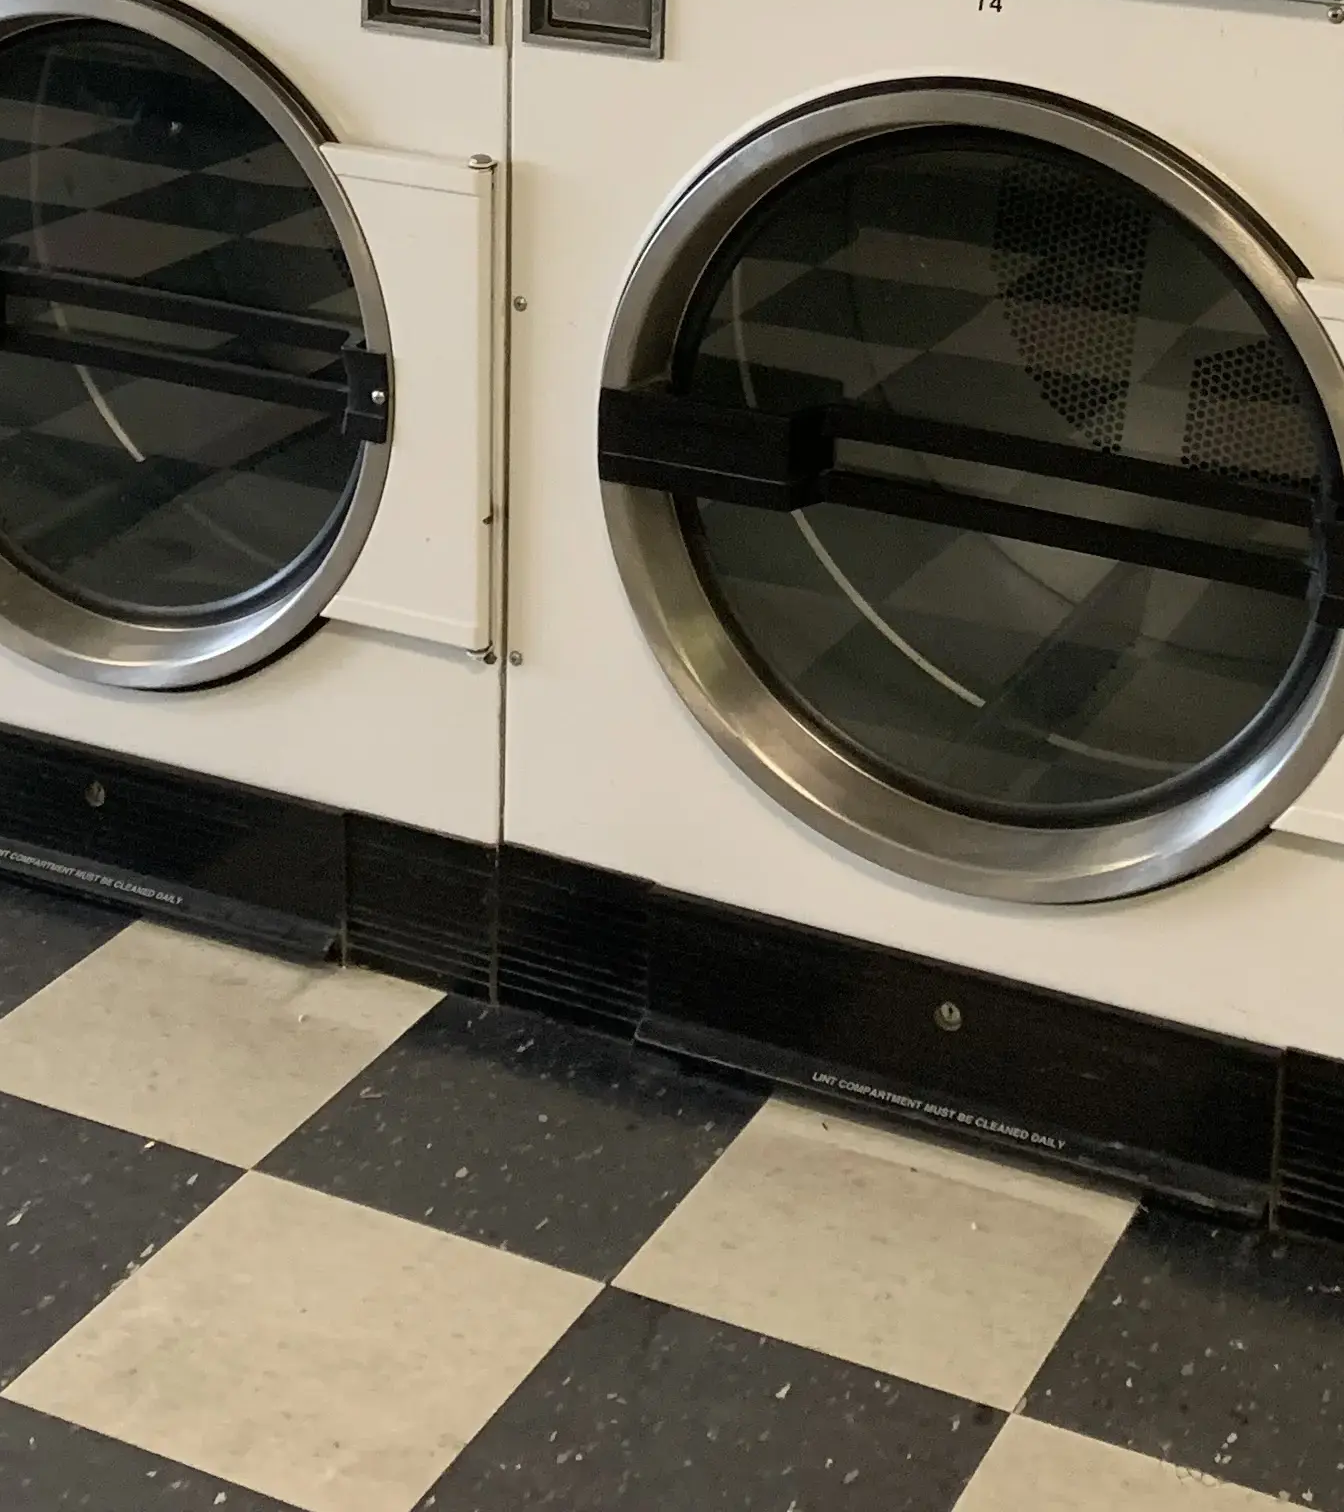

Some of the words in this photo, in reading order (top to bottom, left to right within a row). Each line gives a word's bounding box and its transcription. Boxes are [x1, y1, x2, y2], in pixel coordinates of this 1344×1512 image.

[10, 852, 76, 876] COMPARTMENT
[75, 869, 100, 883] MUST
[113, 879, 155, 898] CLEANED
[156, 890, 184, 905] DAILY
[812, 1071, 837, 1087] LINT
[838, 1079, 923, 1110] COMPARTMENT
[924, 1103, 957, 1119] MUST
[957, 1112, 974, 1125] BE
[975, 1116, 1029, 1140] CLEANED
[1030, 1132, 1066, 1150] DAILY
